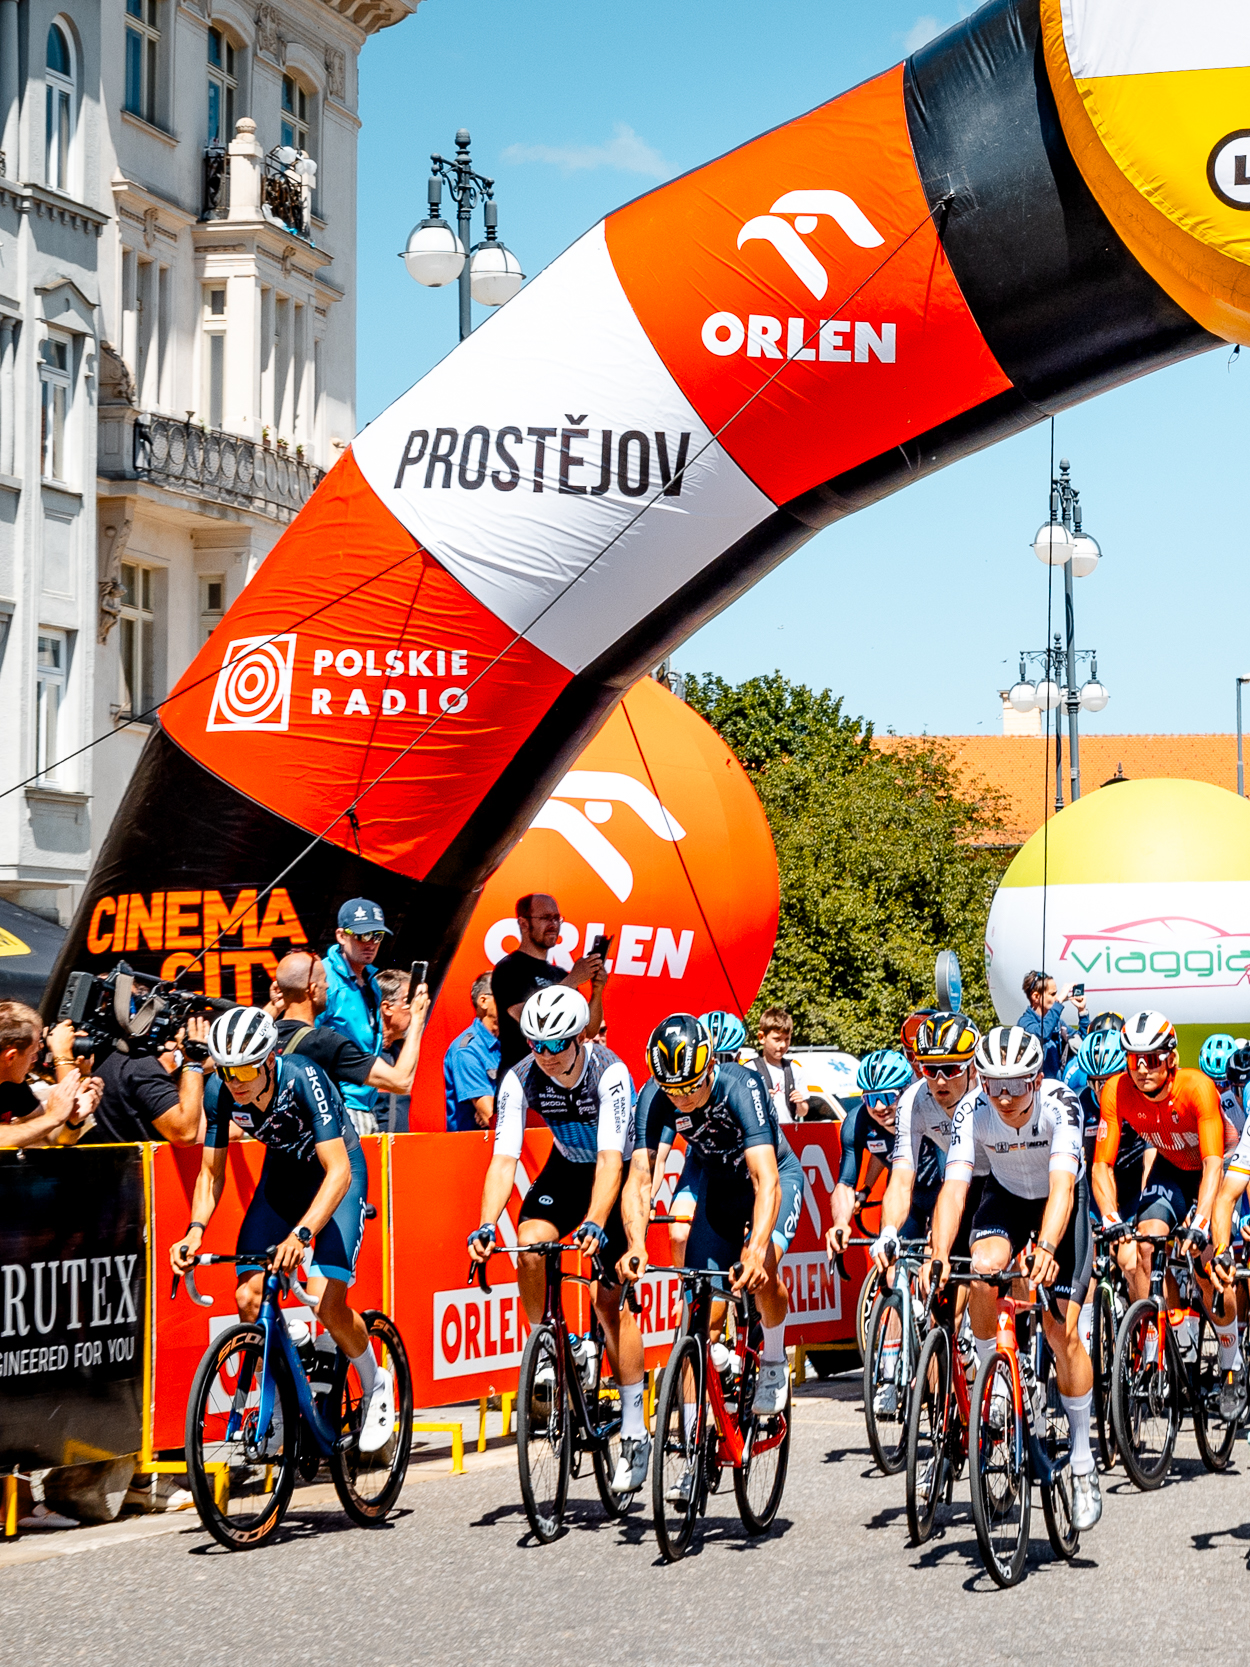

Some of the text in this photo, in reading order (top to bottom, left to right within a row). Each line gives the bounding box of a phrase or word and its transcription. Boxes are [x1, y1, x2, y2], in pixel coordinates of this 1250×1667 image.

[701, 311, 896, 364] ORLEN
[394, 414, 692, 497] PROSTĚJOV
[312, 648, 469, 677] POLSKIE
[311, 687, 469, 715] RADIO
[87, 887, 308, 955] CINEMA
[781, 1261, 836, 1313] RLEN
[73, 1342, 102, 1368] FOR
[106, 1336, 135, 1363] YOU
